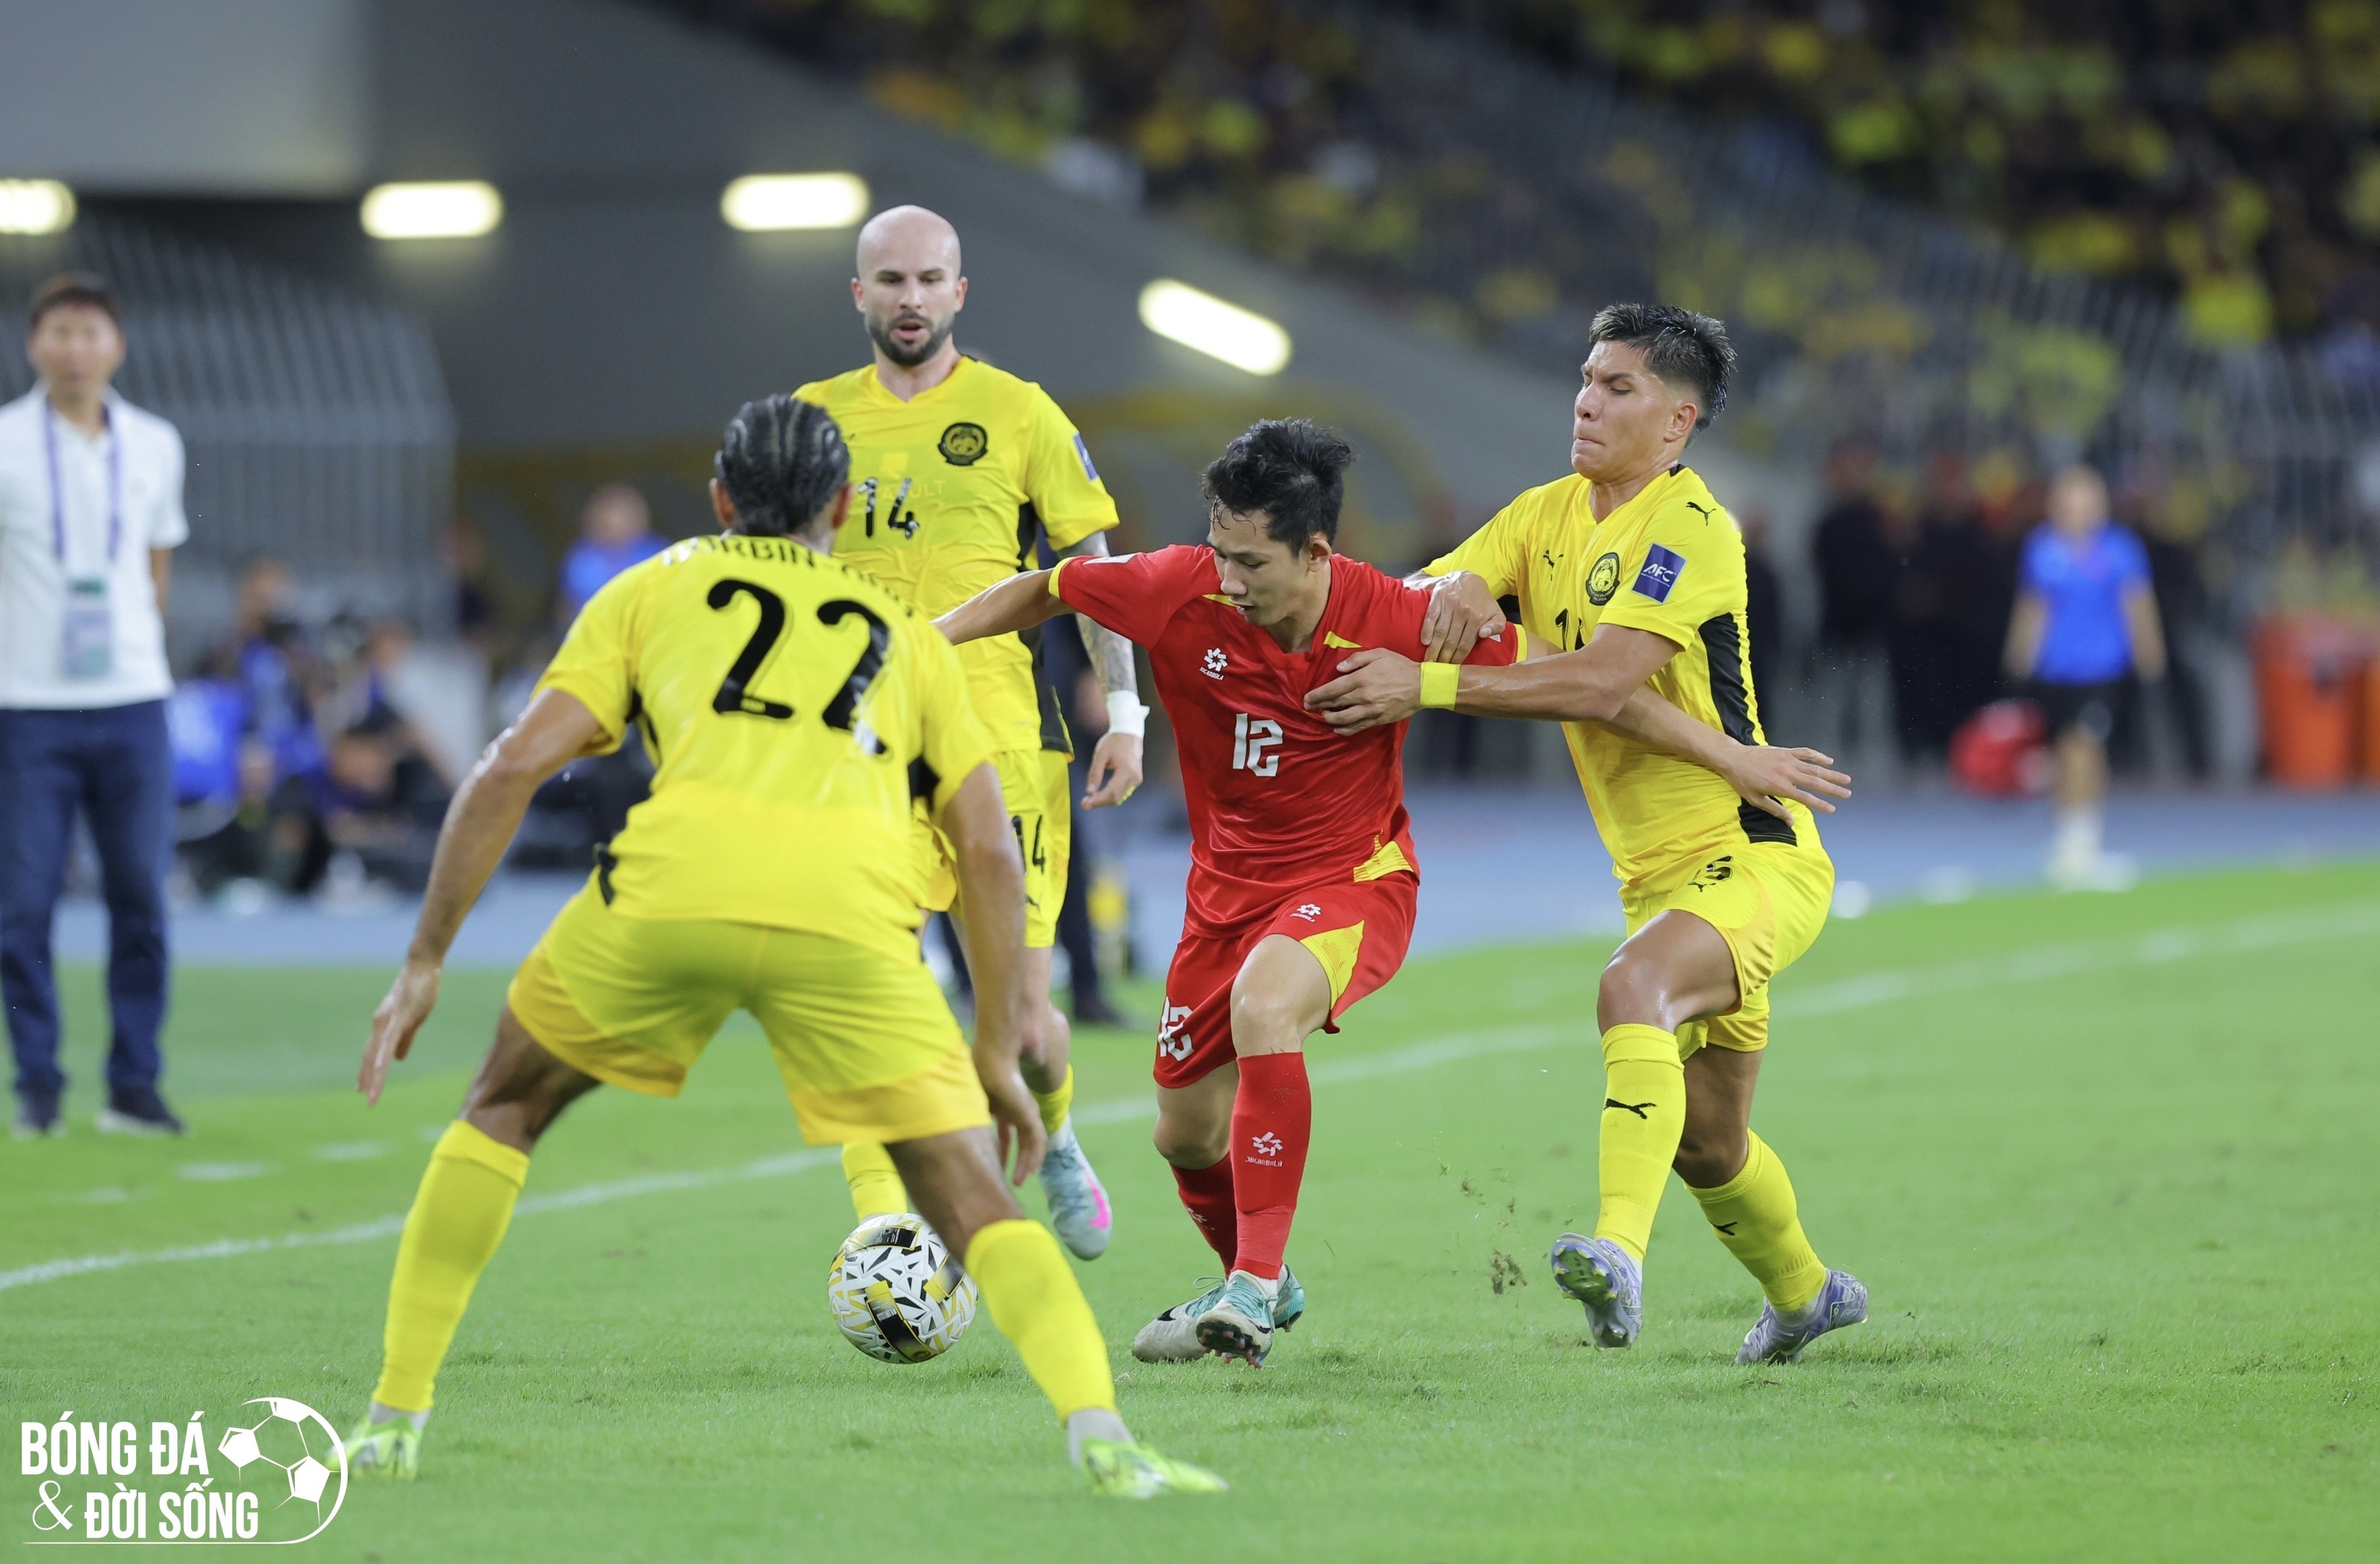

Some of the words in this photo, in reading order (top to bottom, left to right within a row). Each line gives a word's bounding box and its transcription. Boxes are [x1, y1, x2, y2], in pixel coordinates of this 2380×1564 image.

[858, 477, 920, 539] 14
[1642, 563, 1674, 582] AFC
[707, 576, 890, 755] 22
[1232, 712, 1283, 777] 12
[1158, 996, 1194, 1062] 12
